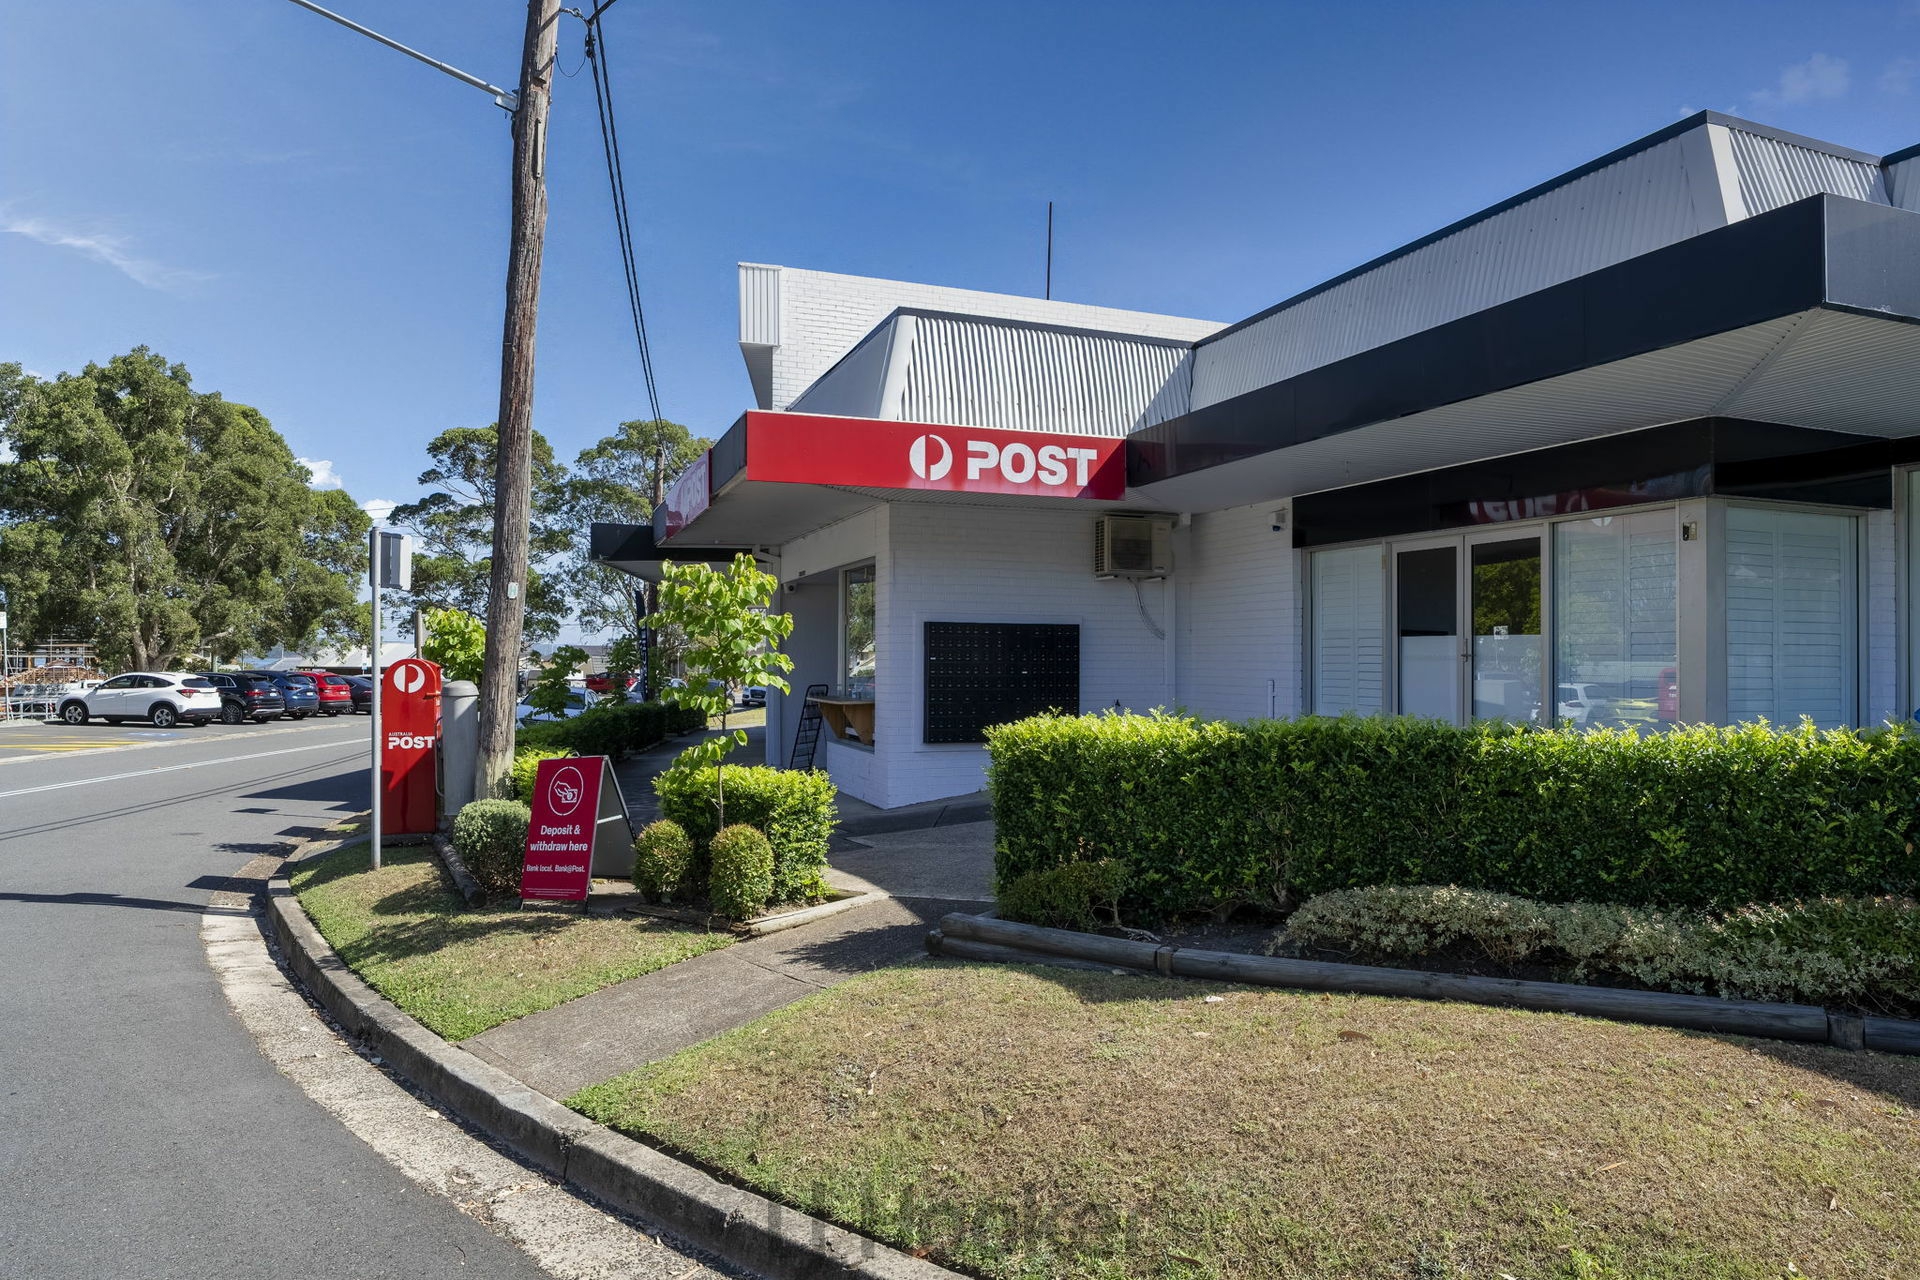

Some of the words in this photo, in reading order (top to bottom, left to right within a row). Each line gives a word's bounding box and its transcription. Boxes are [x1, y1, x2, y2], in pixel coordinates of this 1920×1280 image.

[967, 440, 1097, 487] POST
[388, 736, 435, 750] POST
[540, 824, 573, 836] Deposit
[574, 824, 581, 835] &
[530, 841, 568, 851] withdraw
[568, 841, 588, 851] here
[526, 864, 539, 872] Bank
